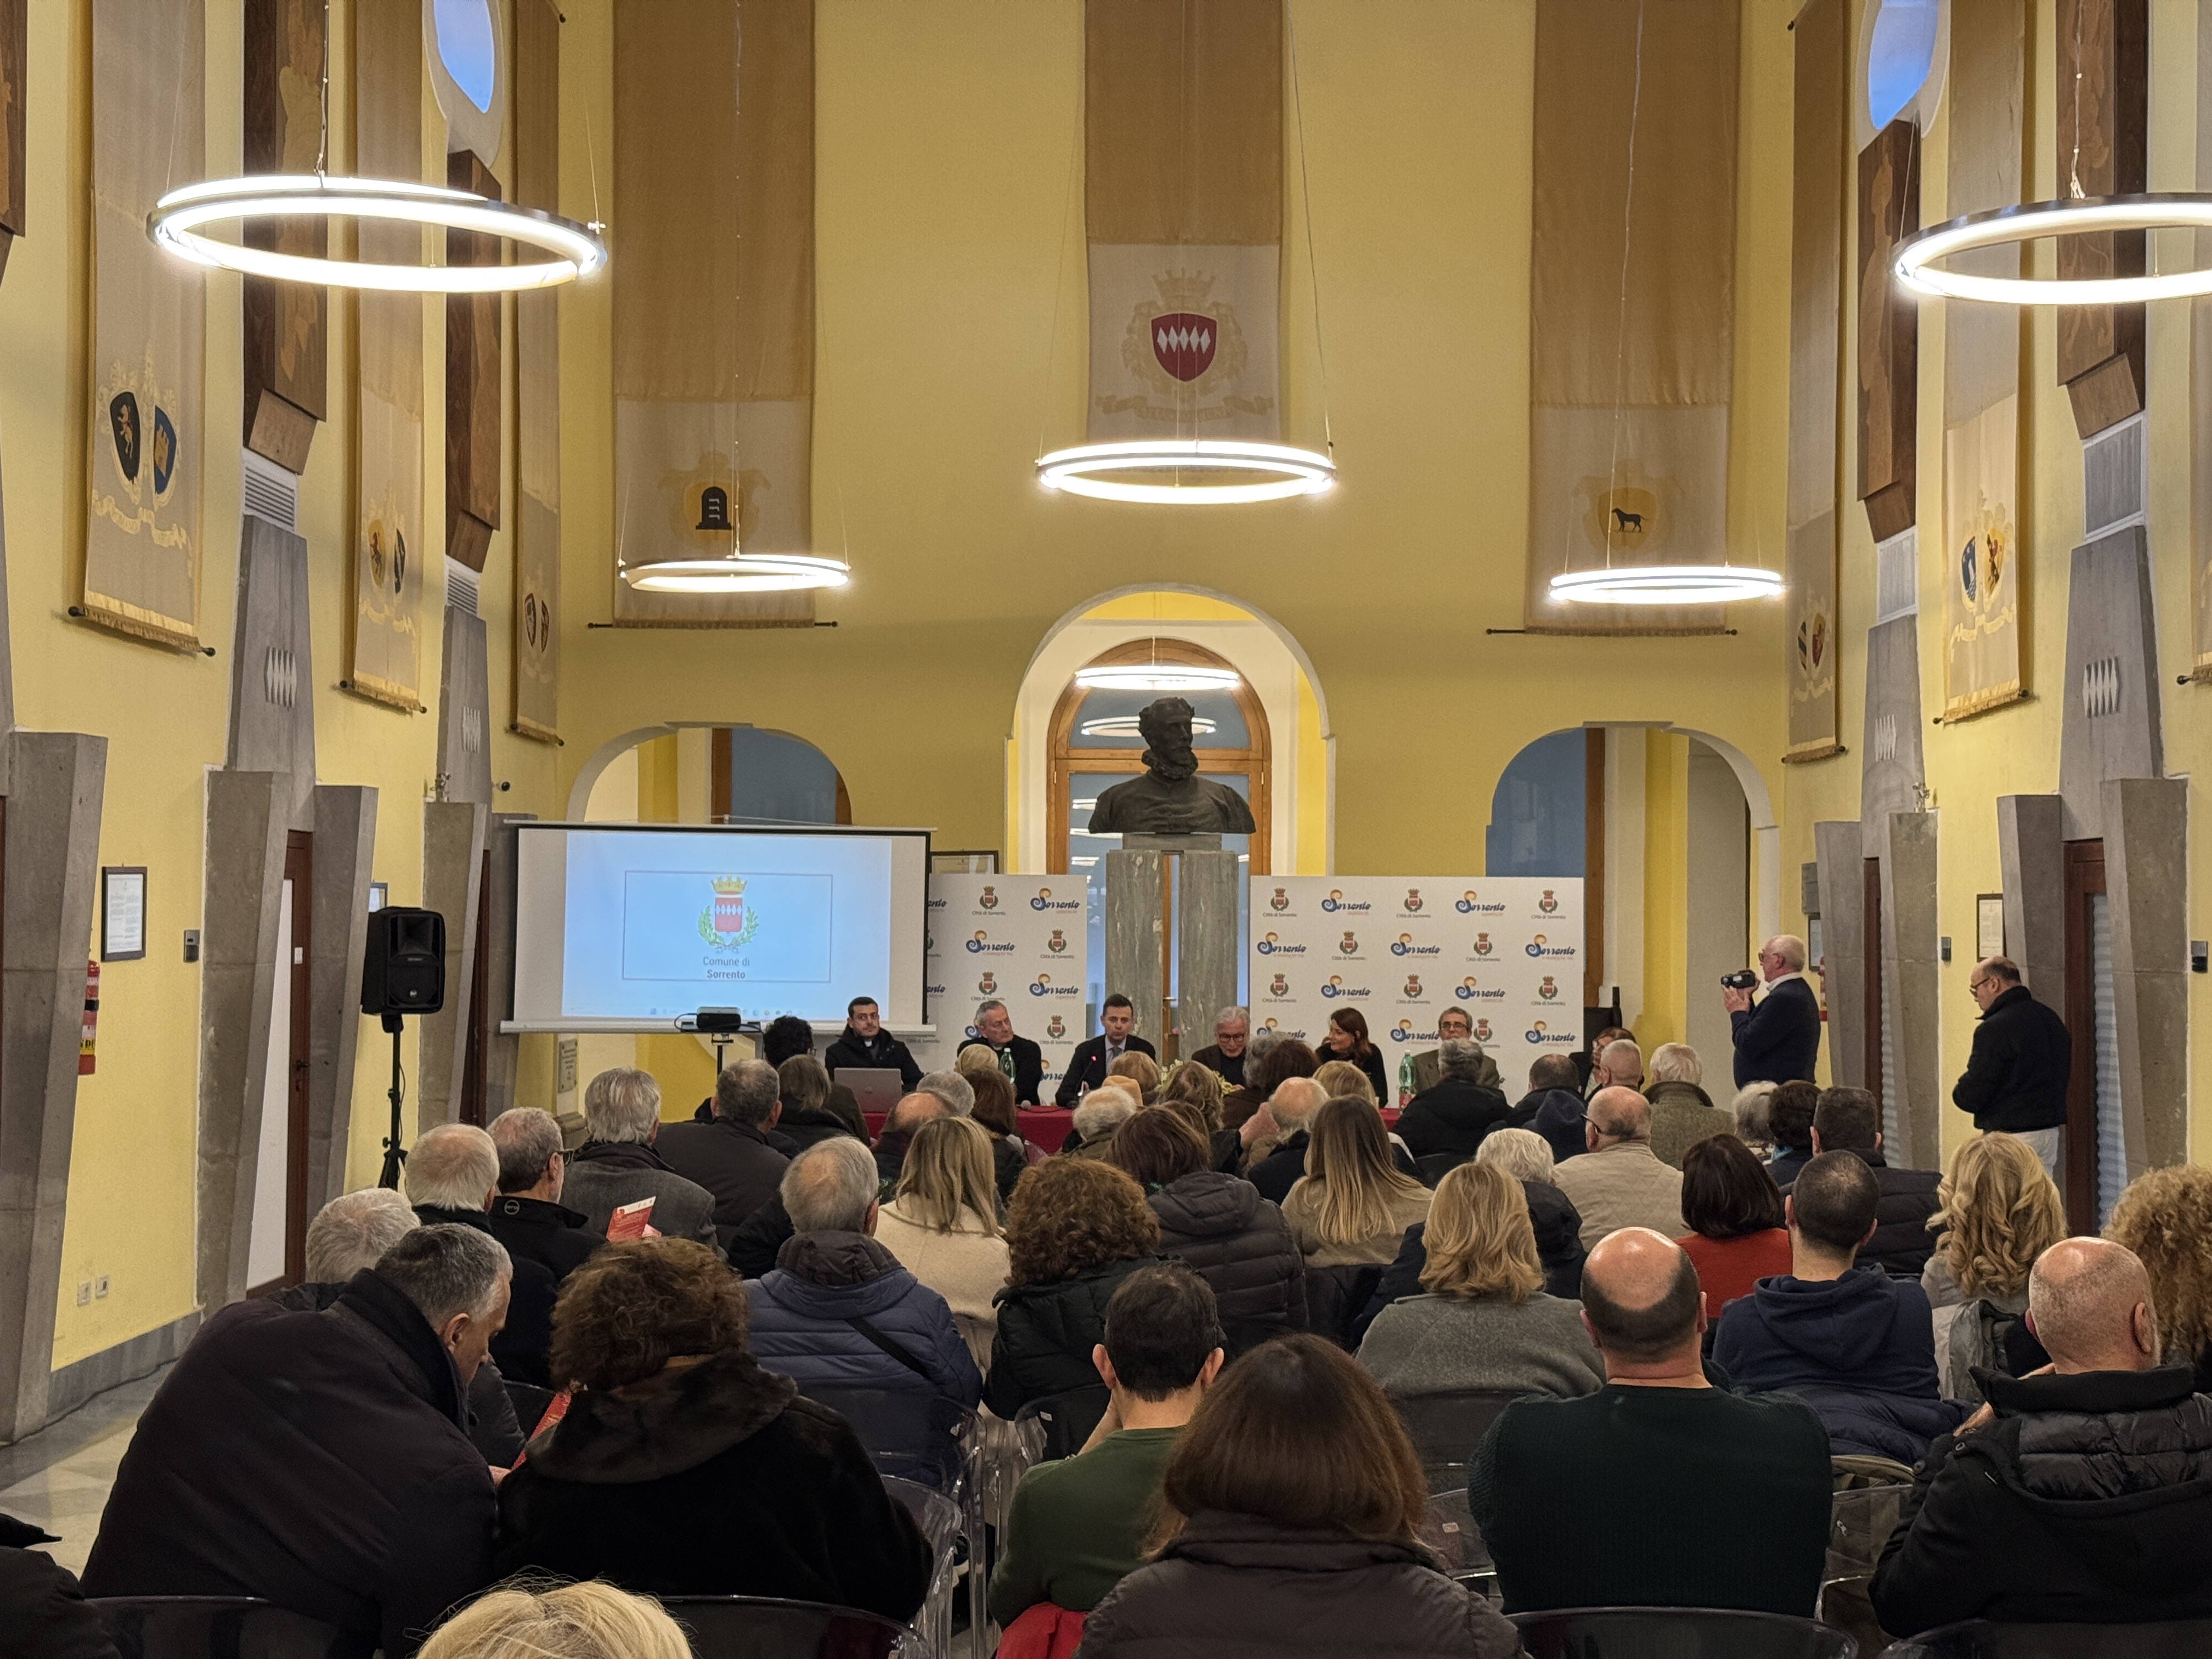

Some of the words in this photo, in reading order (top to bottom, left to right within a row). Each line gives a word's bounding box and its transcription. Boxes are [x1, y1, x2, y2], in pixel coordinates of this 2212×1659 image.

[703, 956, 740, 966] Comune
[742, 957, 750, 966] di
[707, 969, 746, 979] Sorrento
